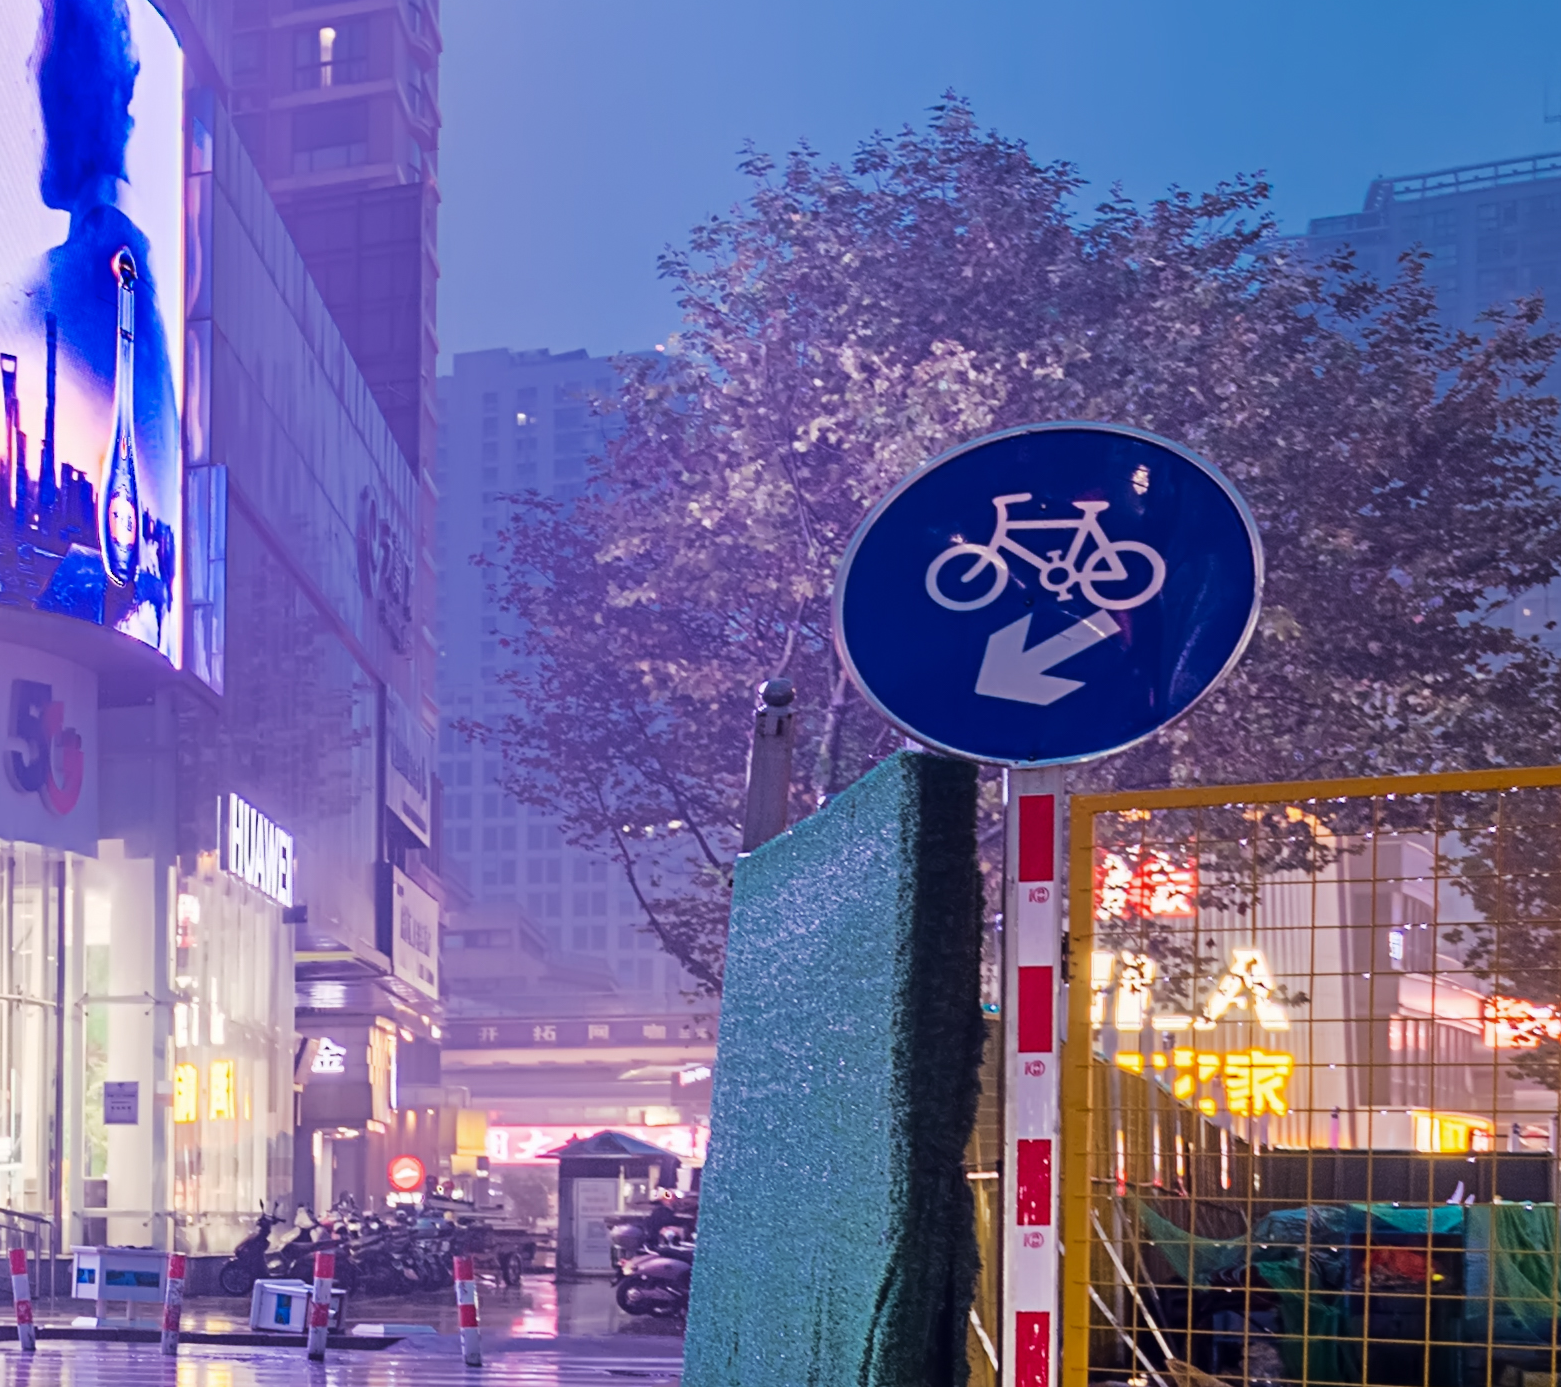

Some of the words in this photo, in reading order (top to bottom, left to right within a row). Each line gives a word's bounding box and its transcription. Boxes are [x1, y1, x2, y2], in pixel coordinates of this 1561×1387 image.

[3, 678, 85, 816] 5G
[229, 792, 294, 909] HUAWEI
[310, 1036, 347, 1073] 金
